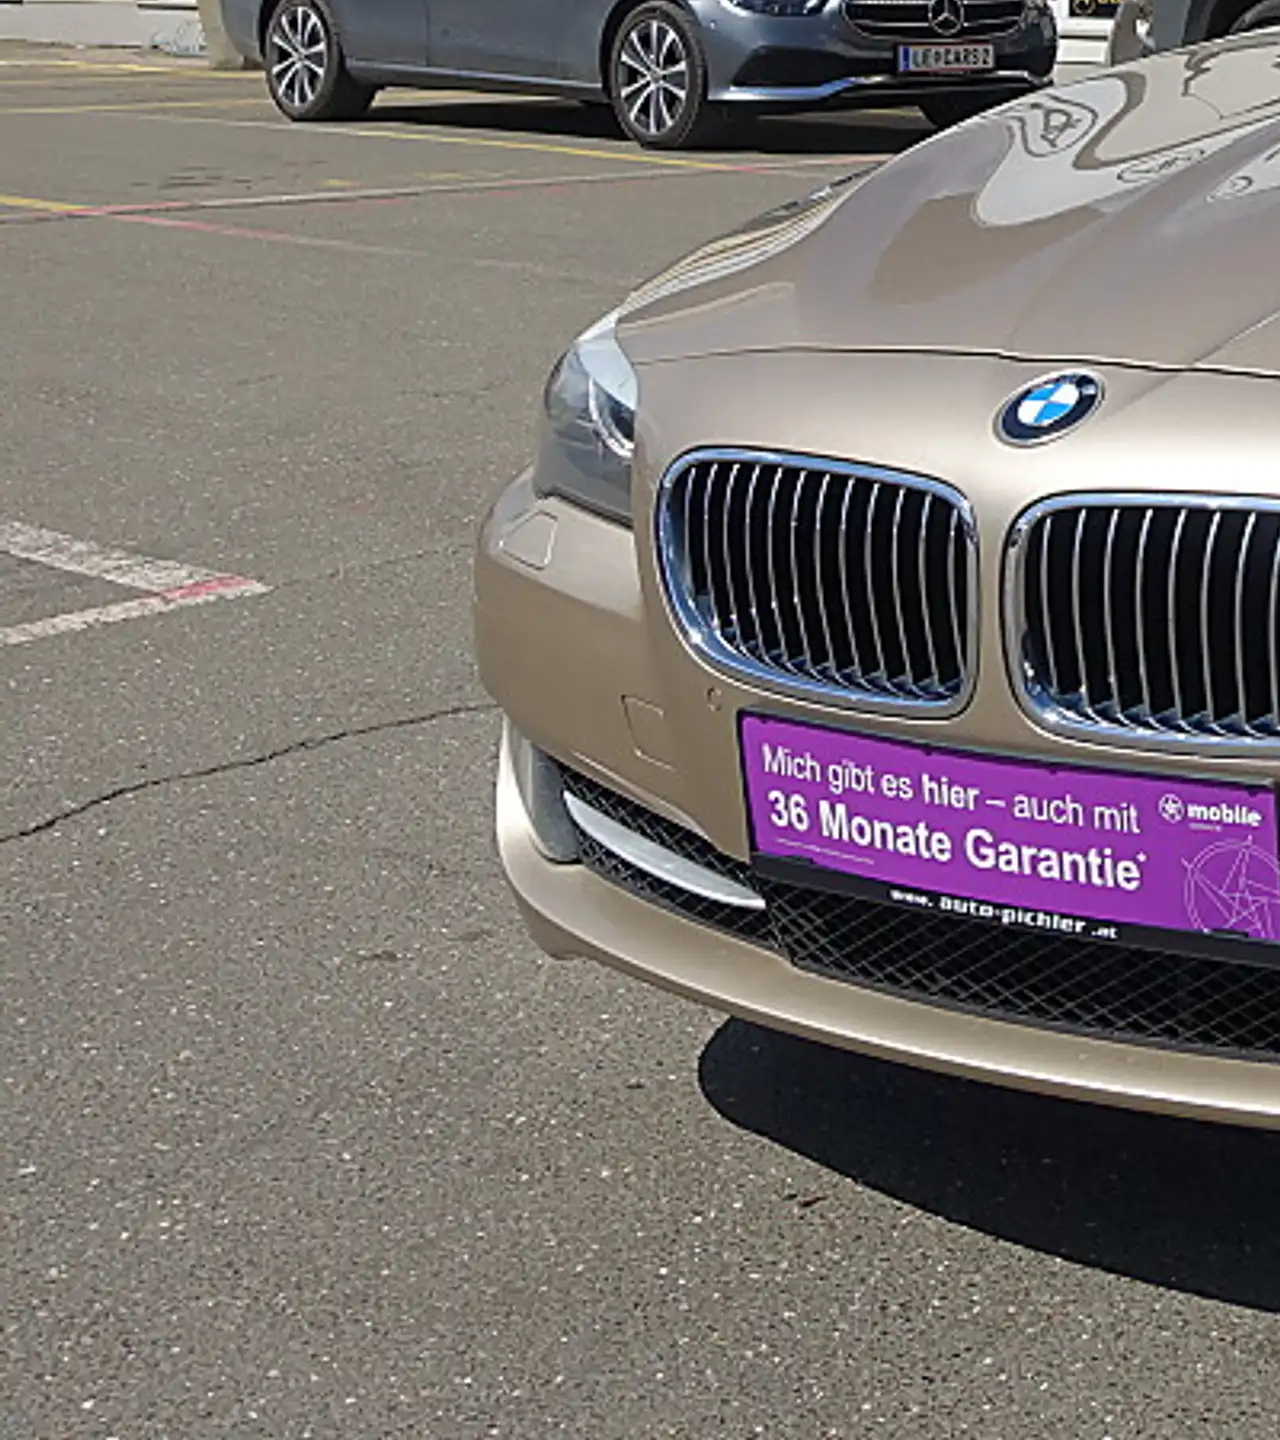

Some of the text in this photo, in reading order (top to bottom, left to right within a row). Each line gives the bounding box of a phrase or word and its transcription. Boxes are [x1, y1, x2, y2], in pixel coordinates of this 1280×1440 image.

[762, 743, 821, 784] Mich
[828, 761, 875, 795] gibt
[881, 773, 914, 799] es
[921, 773, 980, 811] hier
[1014, 794, 1084, 827] auch
[1094, 802, 1141, 834] mit
[1187, 804, 1262, 828] mobile
[768, 790, 809, 832] 36
[819, 799, 952, 863] Monate
[939, 895, 1087, 935] auto-pichler
